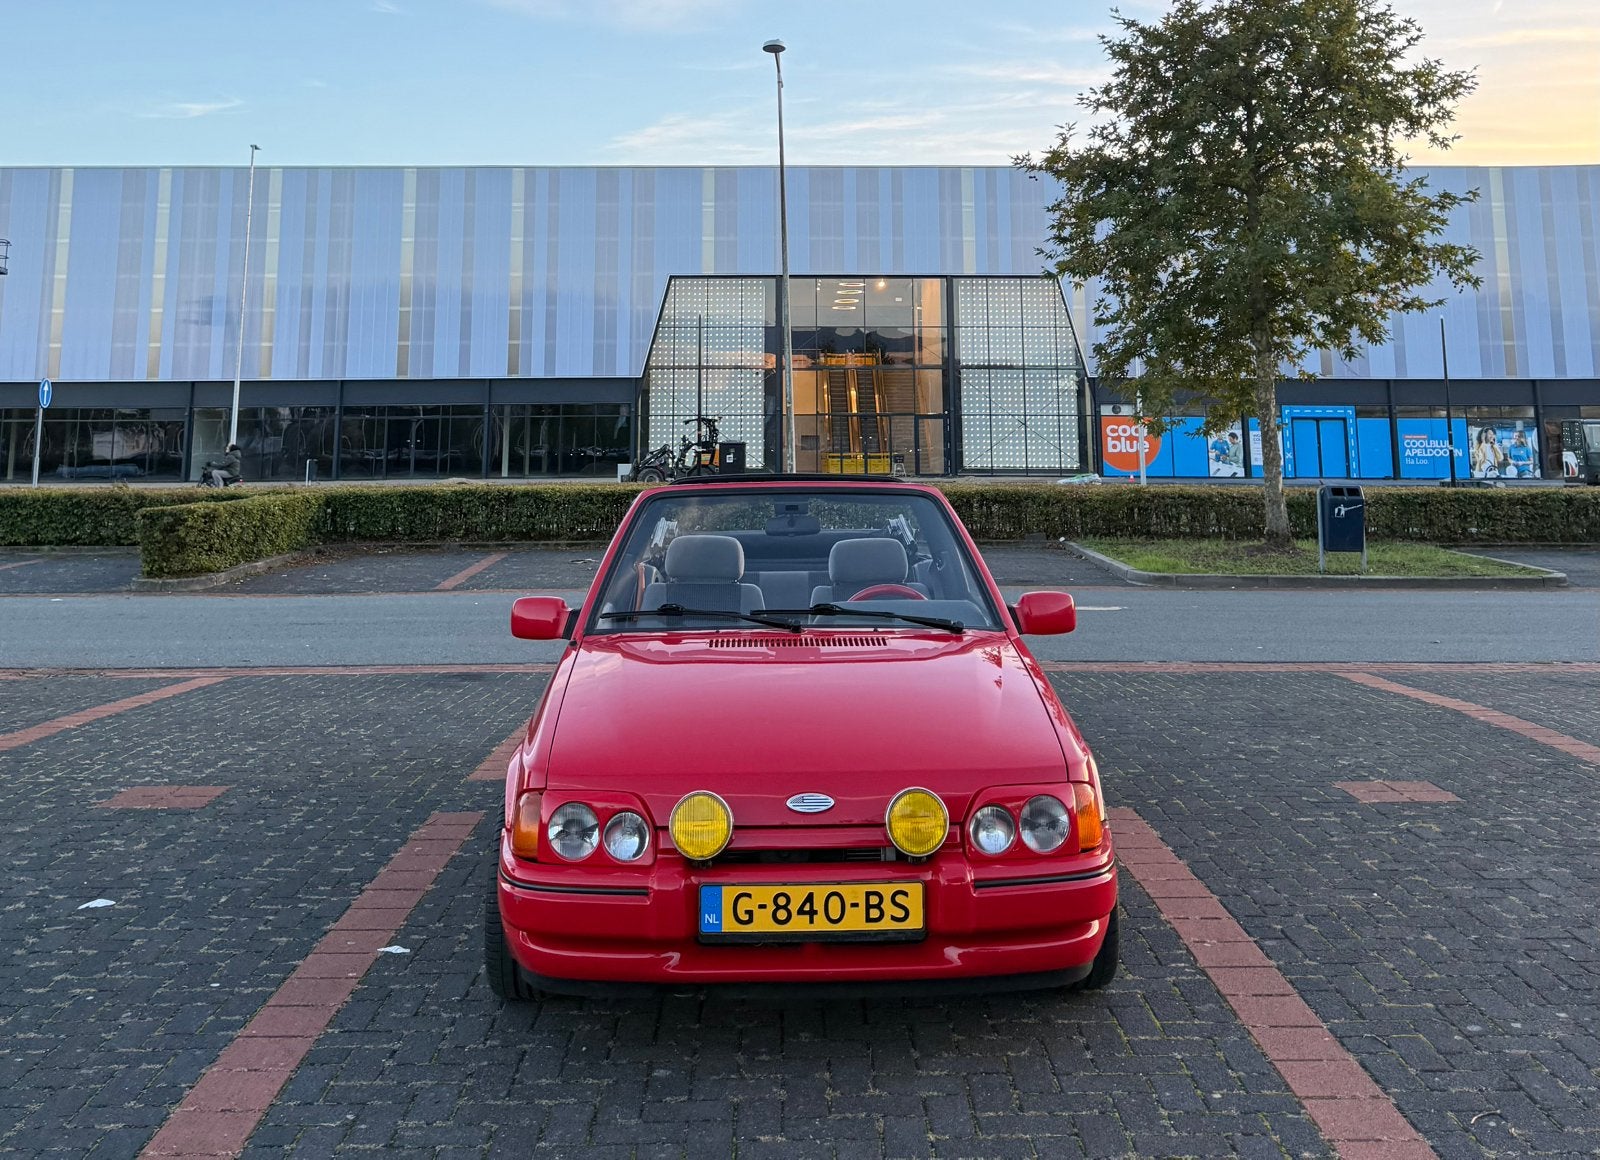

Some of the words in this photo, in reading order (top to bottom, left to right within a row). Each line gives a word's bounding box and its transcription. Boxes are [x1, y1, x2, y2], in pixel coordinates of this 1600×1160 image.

[1107, 436, 1149, 453] blue
[1405, 449, 1462, 457] APELDOON
[704, 913, 719, 924] NL
[732, 890, 910, 925] G-840-BS
